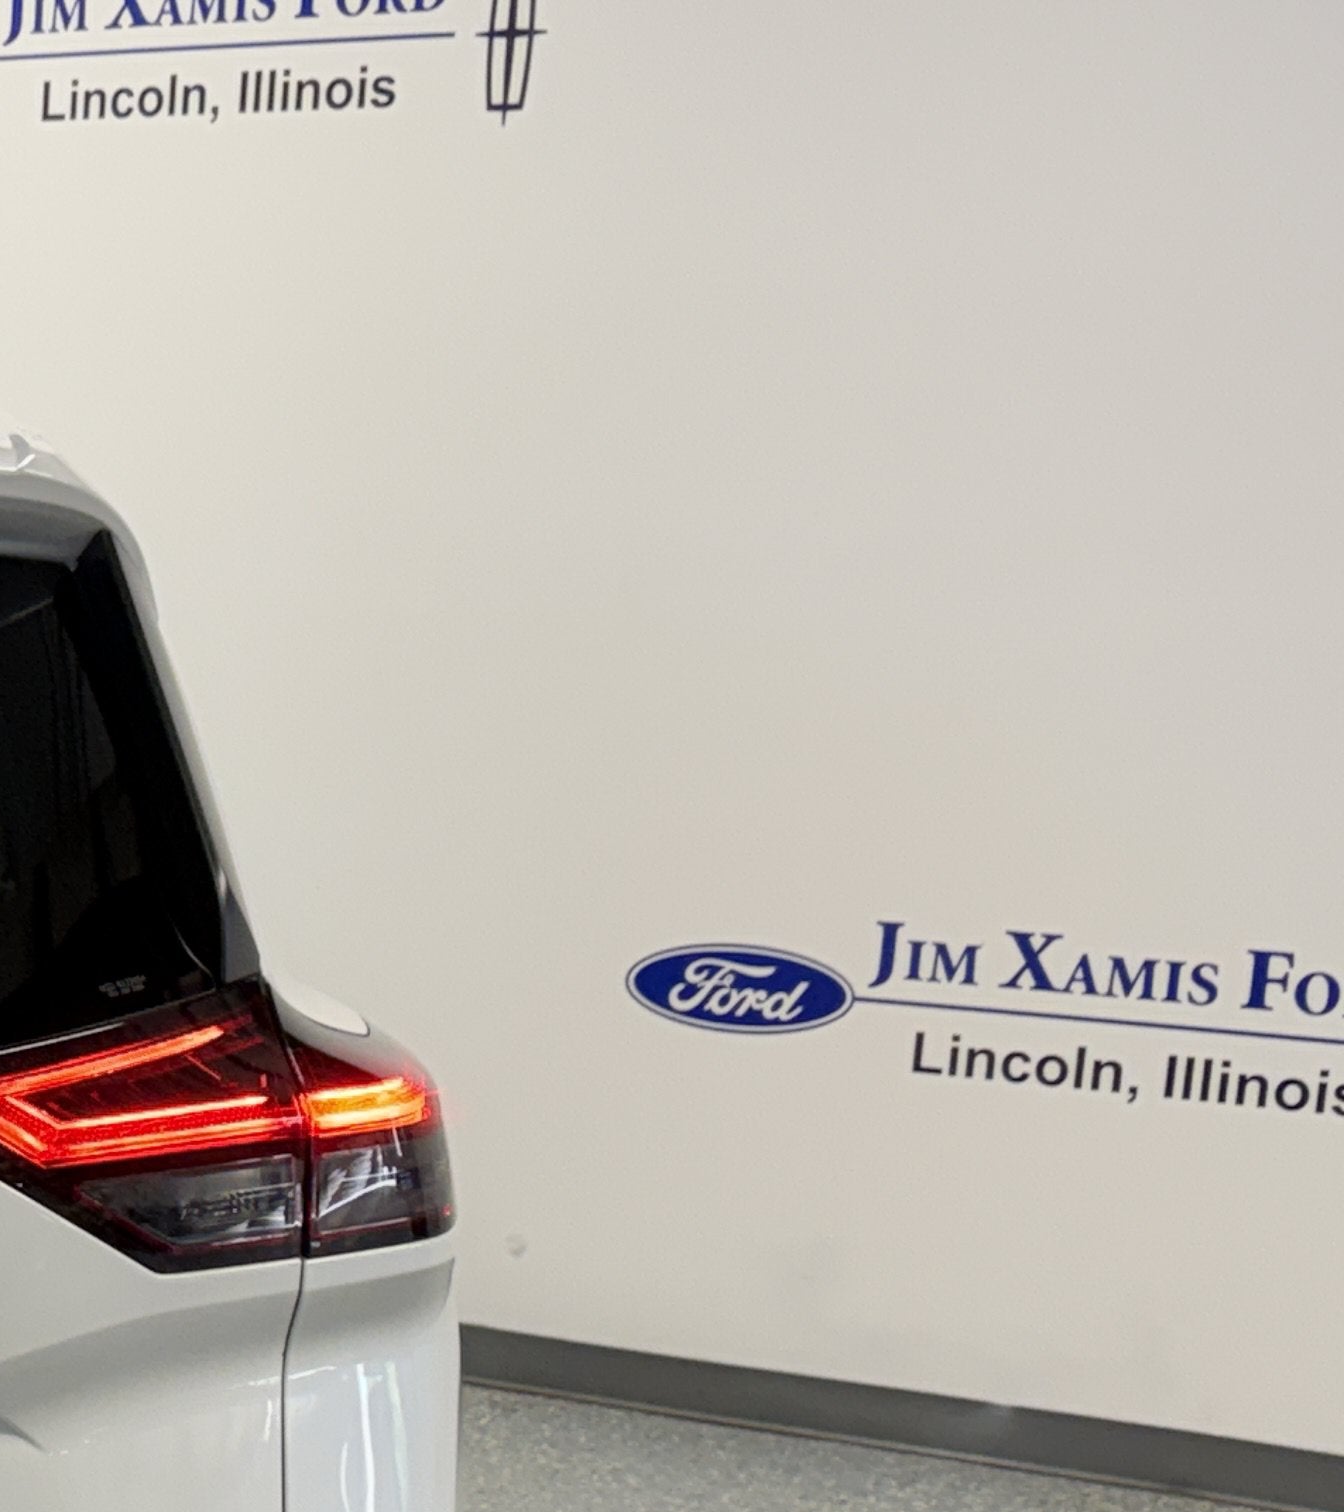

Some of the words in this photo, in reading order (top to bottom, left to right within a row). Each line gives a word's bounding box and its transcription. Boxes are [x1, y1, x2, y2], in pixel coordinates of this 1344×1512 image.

[42, 73, 220, 123] Lincoln,
[238, 67, 397, 116] Illinois
[668, 956, 811, 1024] Ford
[868, 919, 983, 989] JIM
[1000, 930, 1220, 1006] XAMIS
[911, 1031, 1140, 1104] Lincoln,
